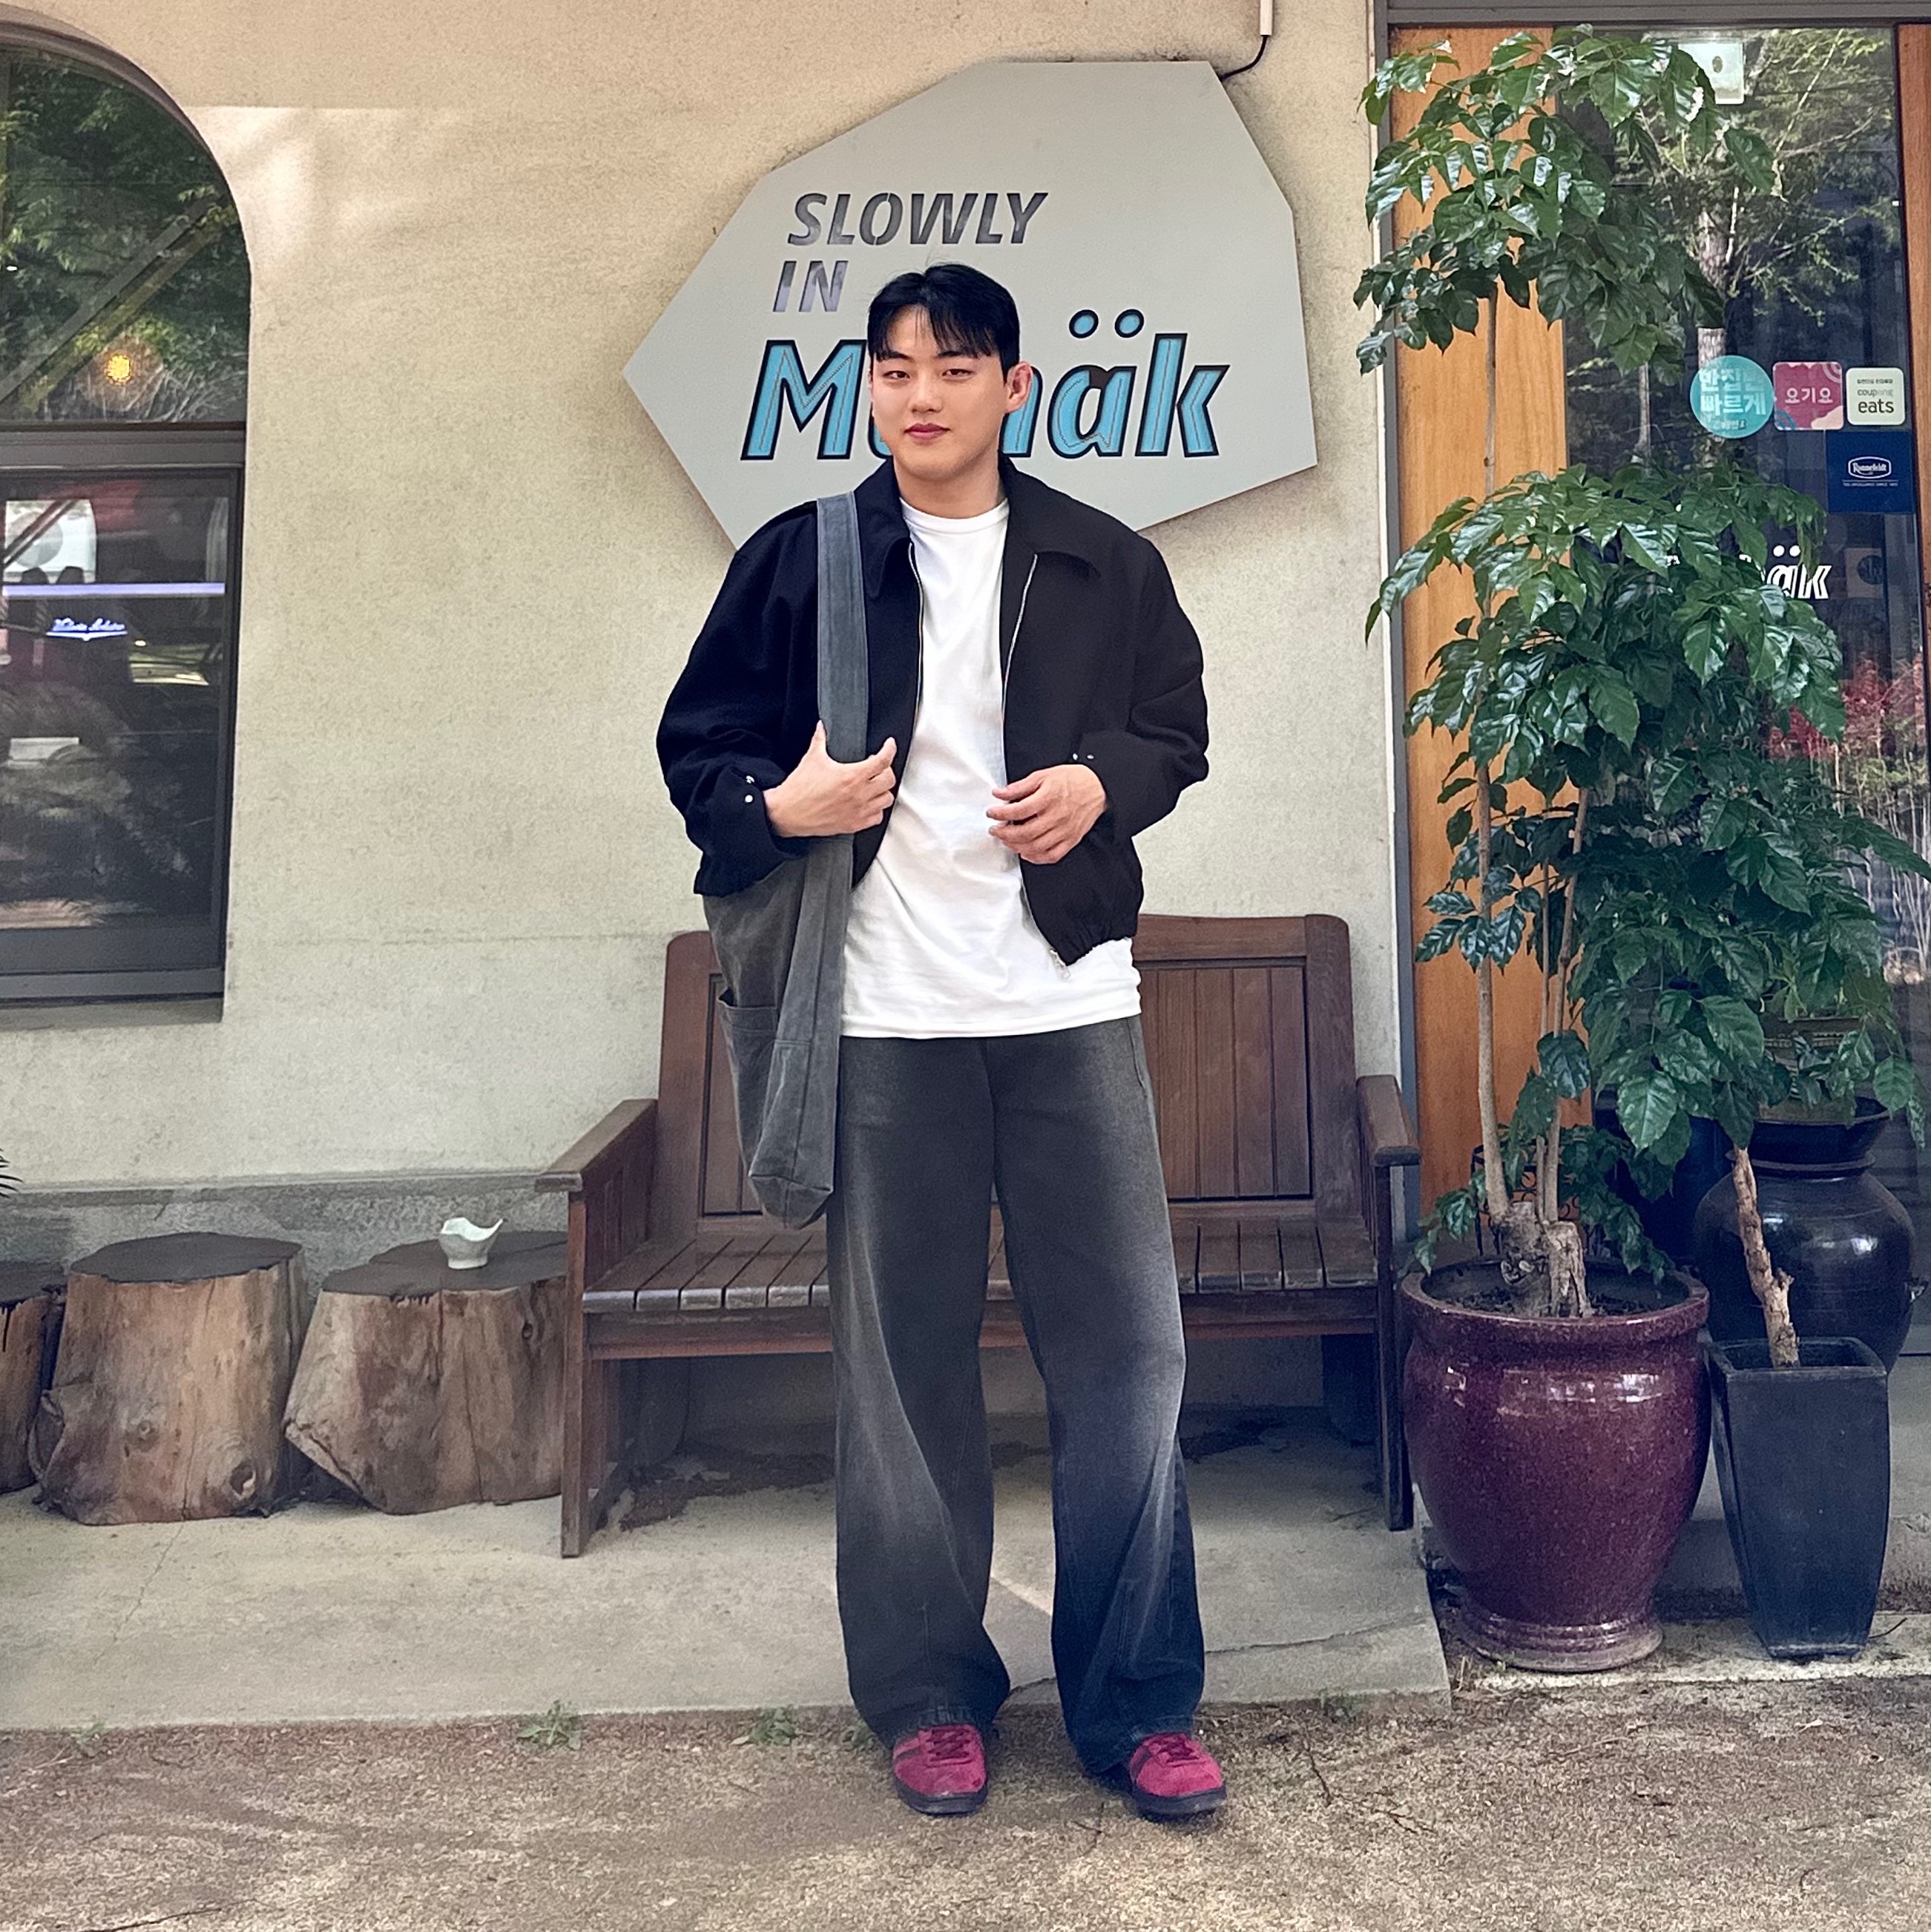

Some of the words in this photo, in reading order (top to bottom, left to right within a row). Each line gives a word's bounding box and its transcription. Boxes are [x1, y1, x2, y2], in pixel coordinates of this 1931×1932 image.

[787, 192, 1049, 246] SLOWLY
[772, 260, 849, 312] IN
[1700, 394, 1766, 416] 빠르게
[1784, 387, 1834, 404] 요기요
[1858, 398, 1895, 414] eats
